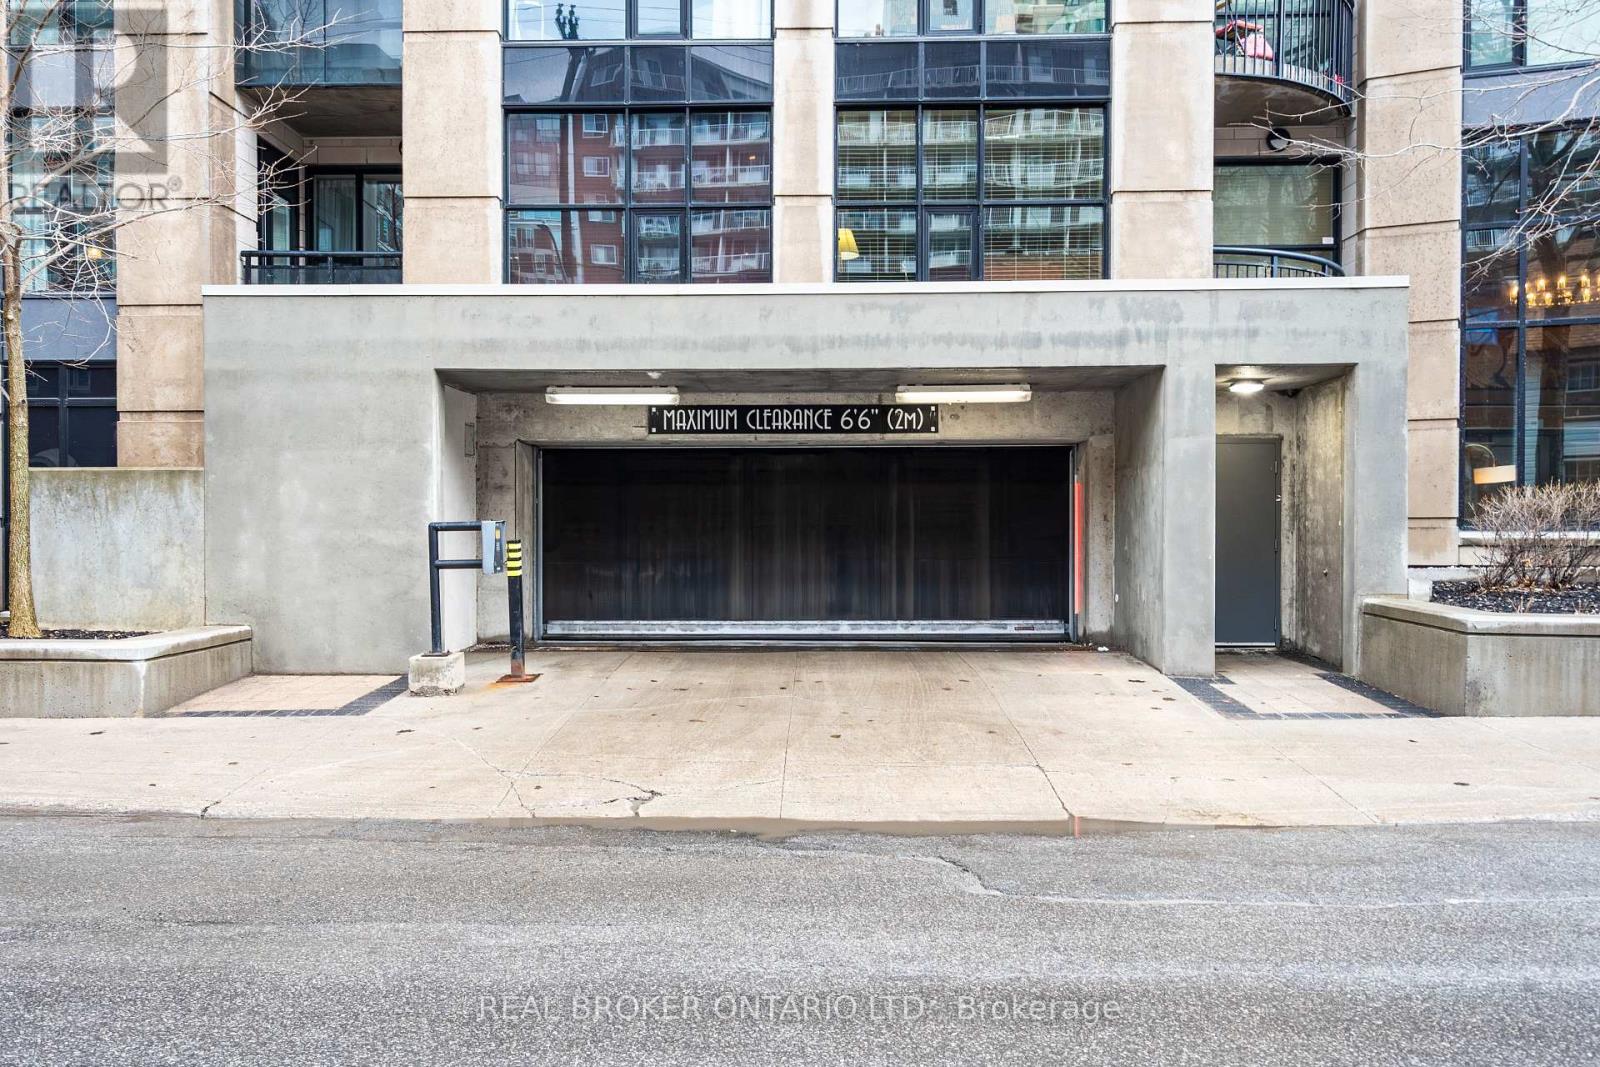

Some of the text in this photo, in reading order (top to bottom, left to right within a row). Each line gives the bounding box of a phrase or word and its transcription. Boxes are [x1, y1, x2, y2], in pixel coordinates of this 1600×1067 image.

[663, 408, 738, 430] MAXIMUM
[746, 408, 832, 430] CLEARANCE
[840, 408, 879, 430] 6'6"
